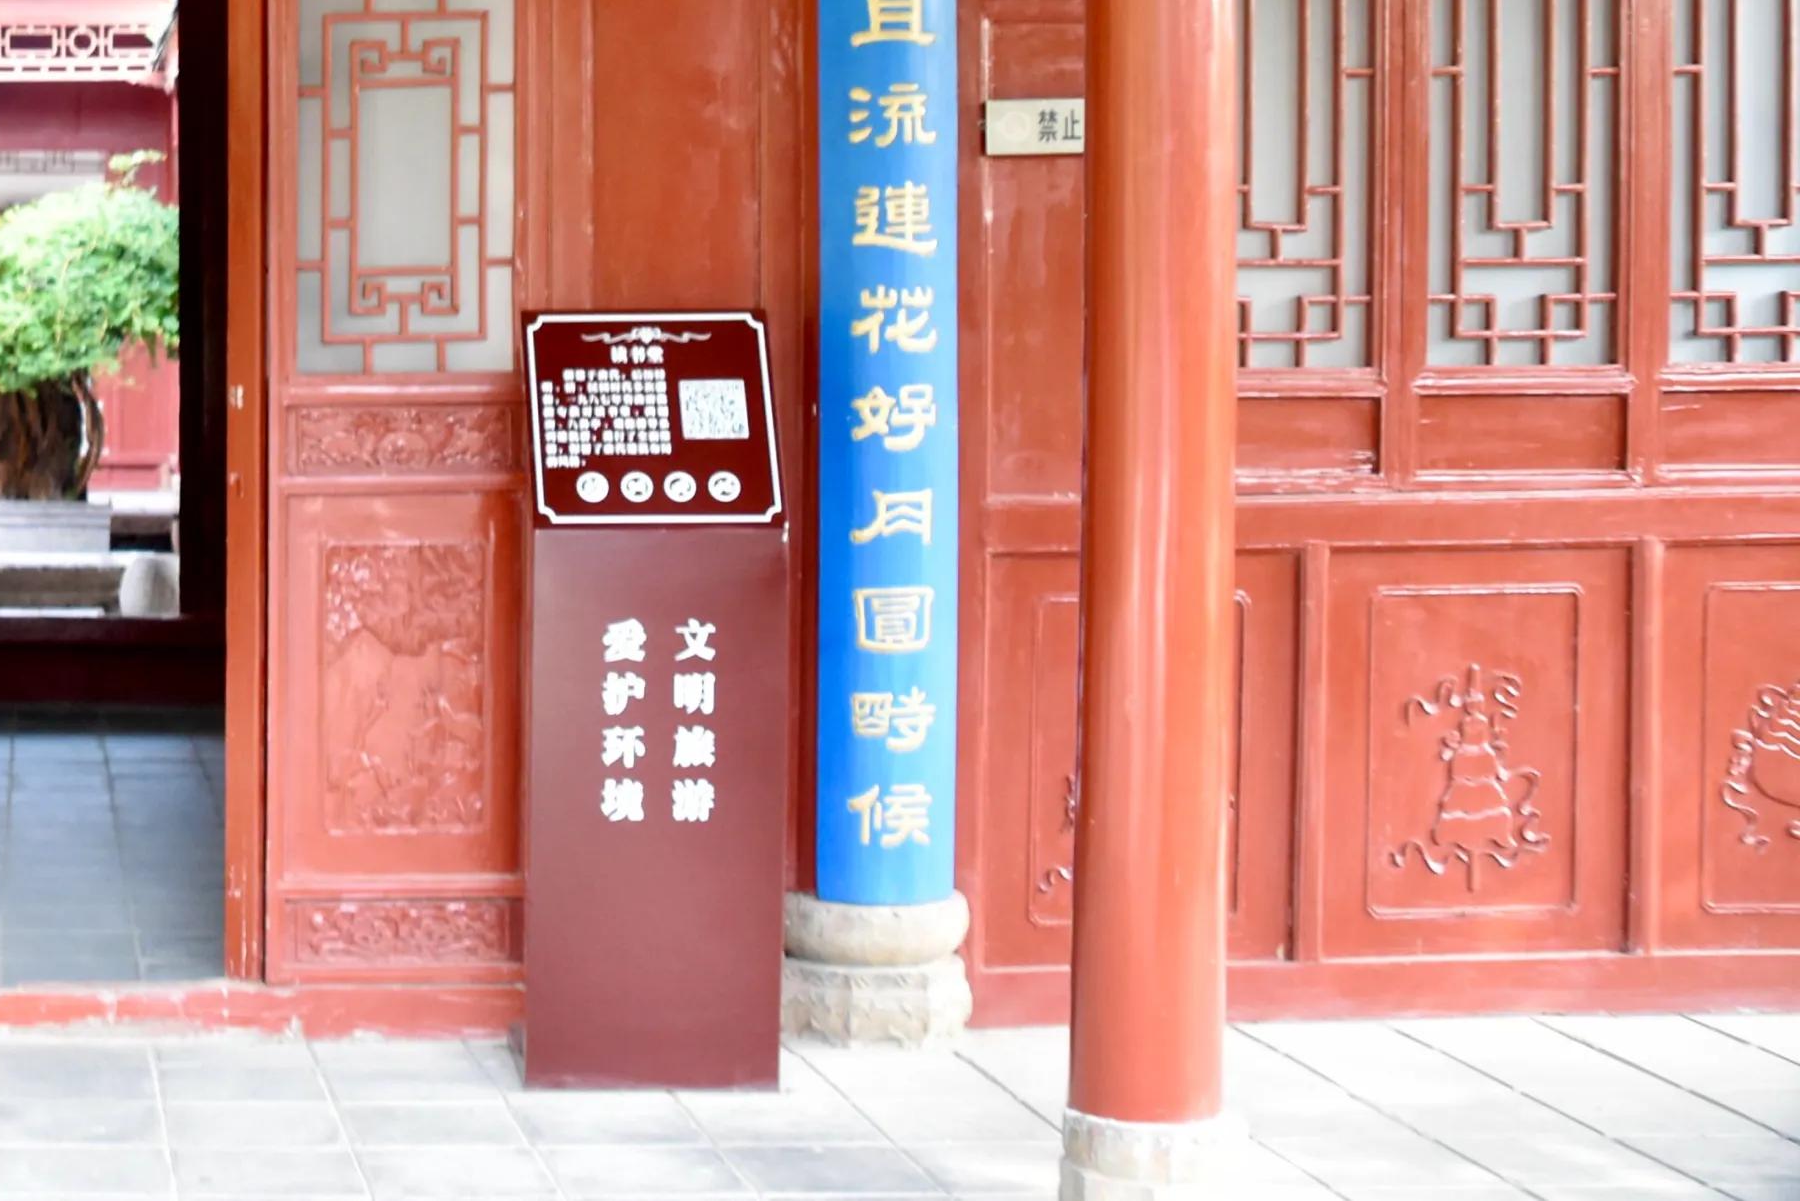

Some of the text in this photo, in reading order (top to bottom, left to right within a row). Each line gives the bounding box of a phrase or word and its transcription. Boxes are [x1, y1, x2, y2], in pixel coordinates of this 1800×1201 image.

[1038, 109, 1082, 142] 禁止
[600, 617, 648, 822] 爱护环境
